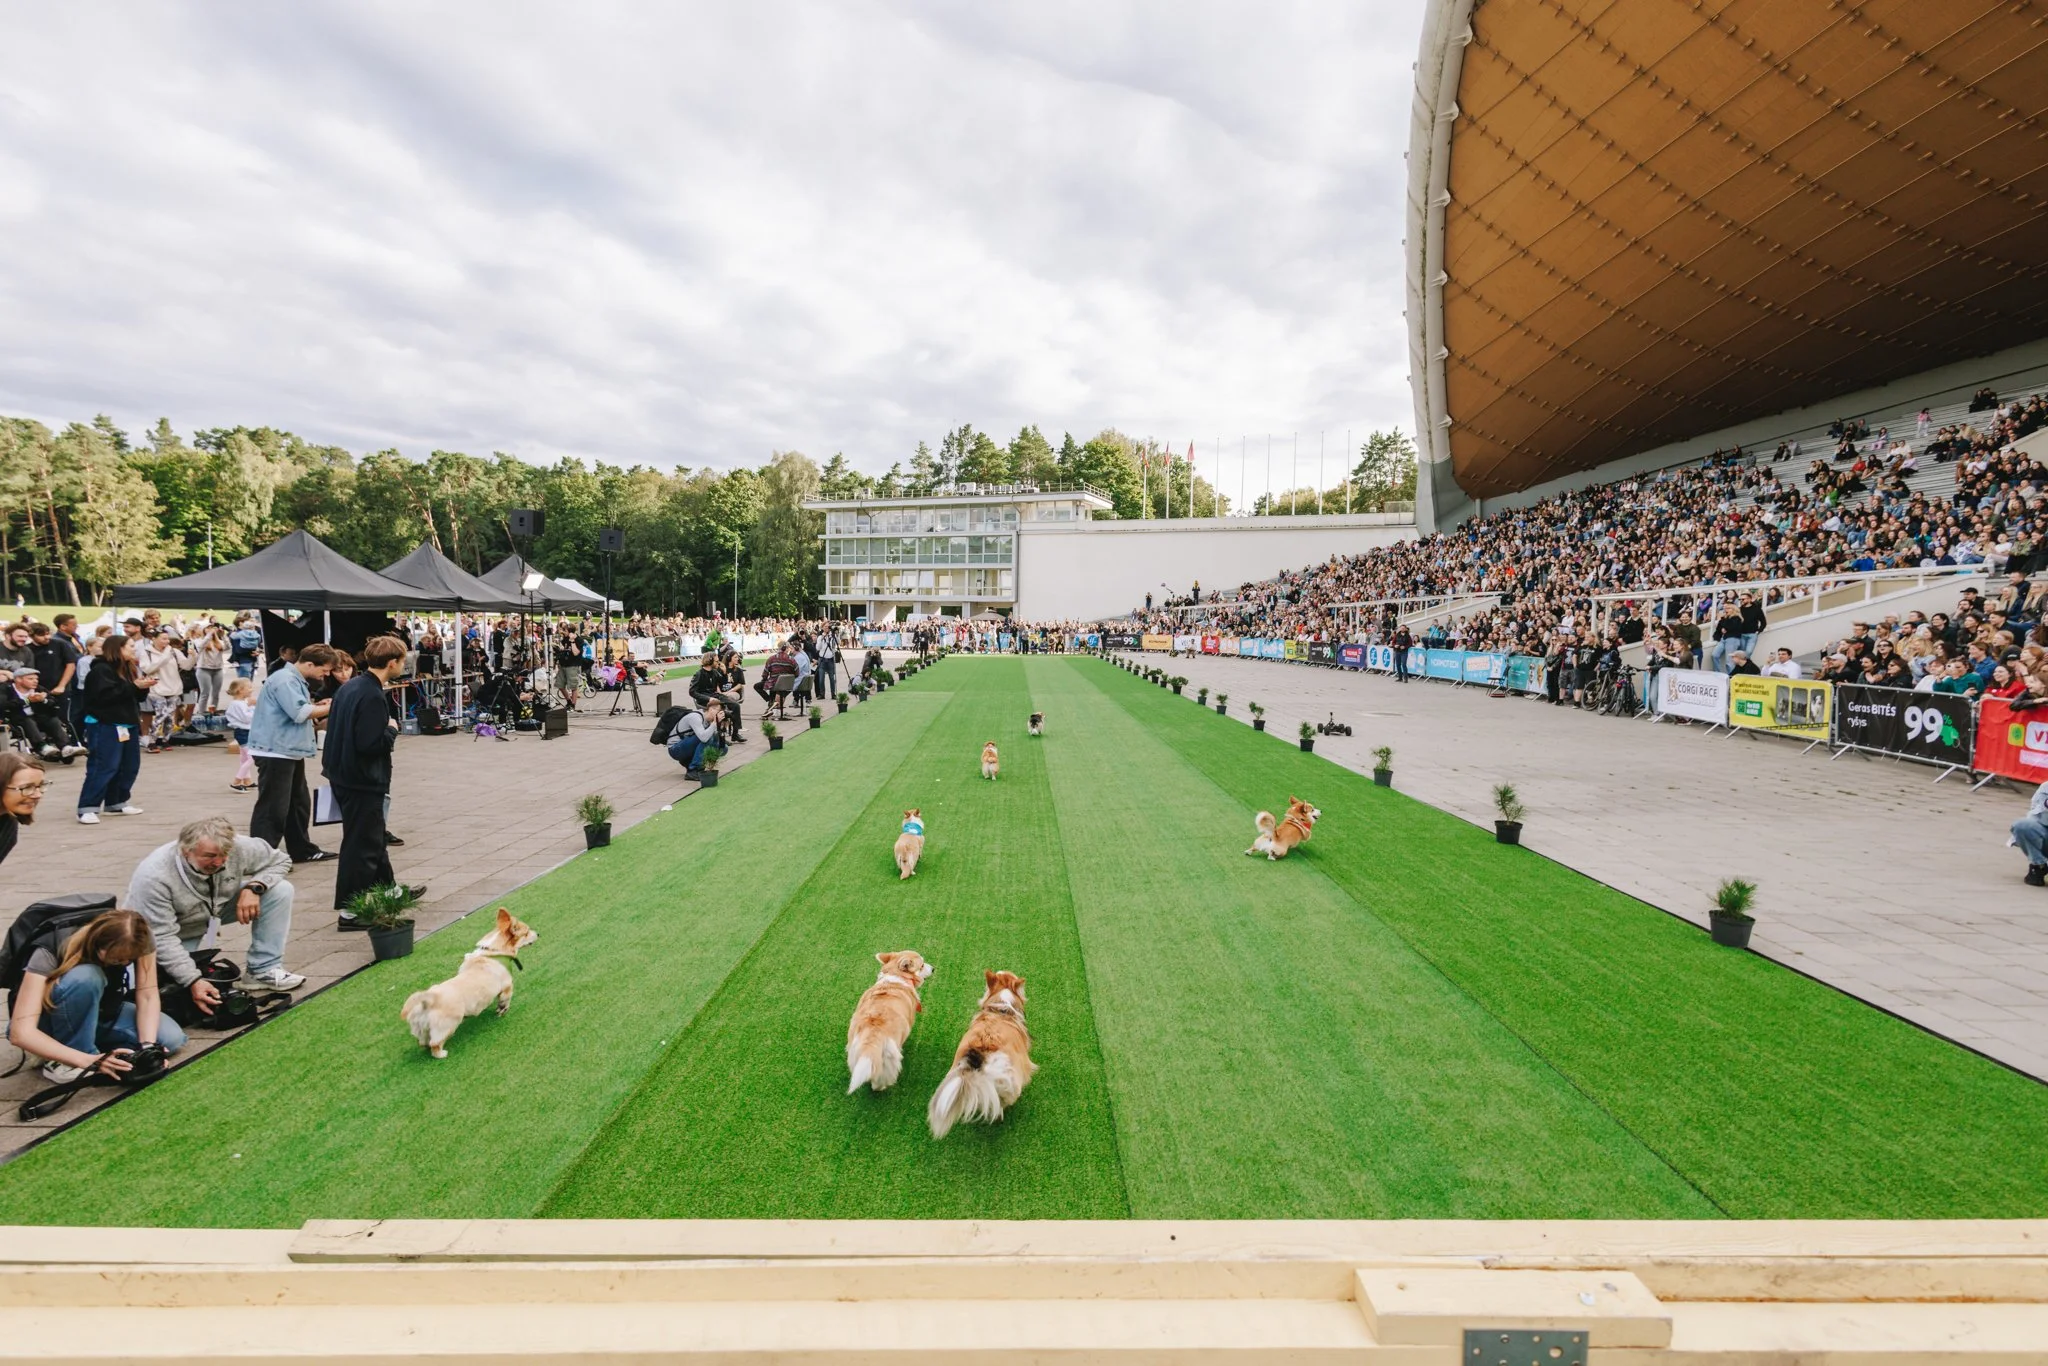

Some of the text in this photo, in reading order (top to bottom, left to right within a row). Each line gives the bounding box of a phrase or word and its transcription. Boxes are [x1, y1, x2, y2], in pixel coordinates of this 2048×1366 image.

[1677, 684, 1718, 698] CORGI RACE
[1848, 701, 1897, 717] Geras BITĖS
